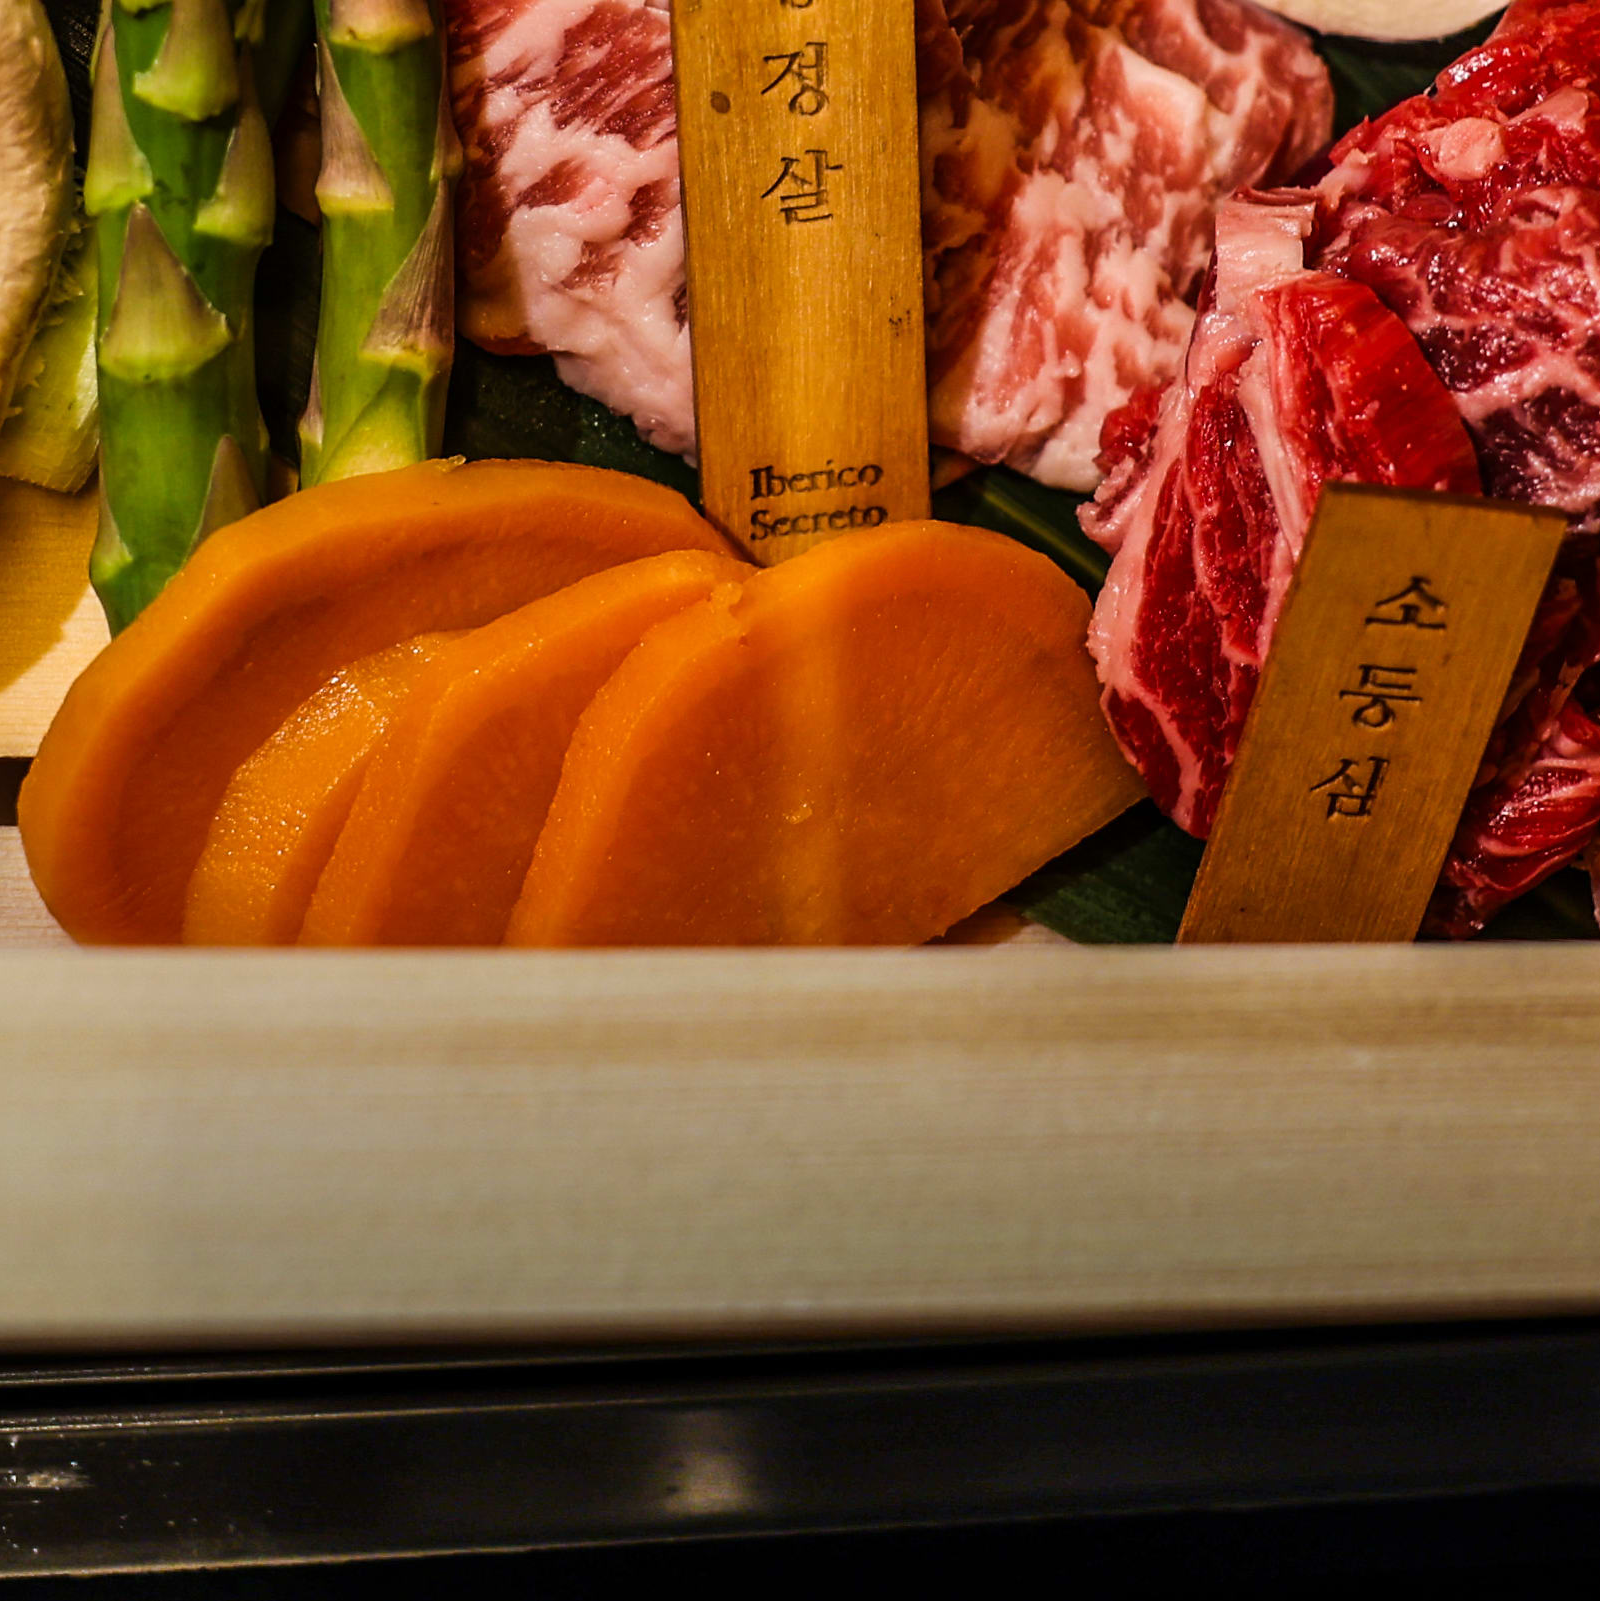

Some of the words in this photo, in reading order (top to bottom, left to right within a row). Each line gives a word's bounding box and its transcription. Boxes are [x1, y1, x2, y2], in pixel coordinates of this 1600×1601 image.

[749, 458, 885, 501] Iberico
[749, 504, 889, 542] Secreto
[1309, 574, 1448, 824] 소등심
